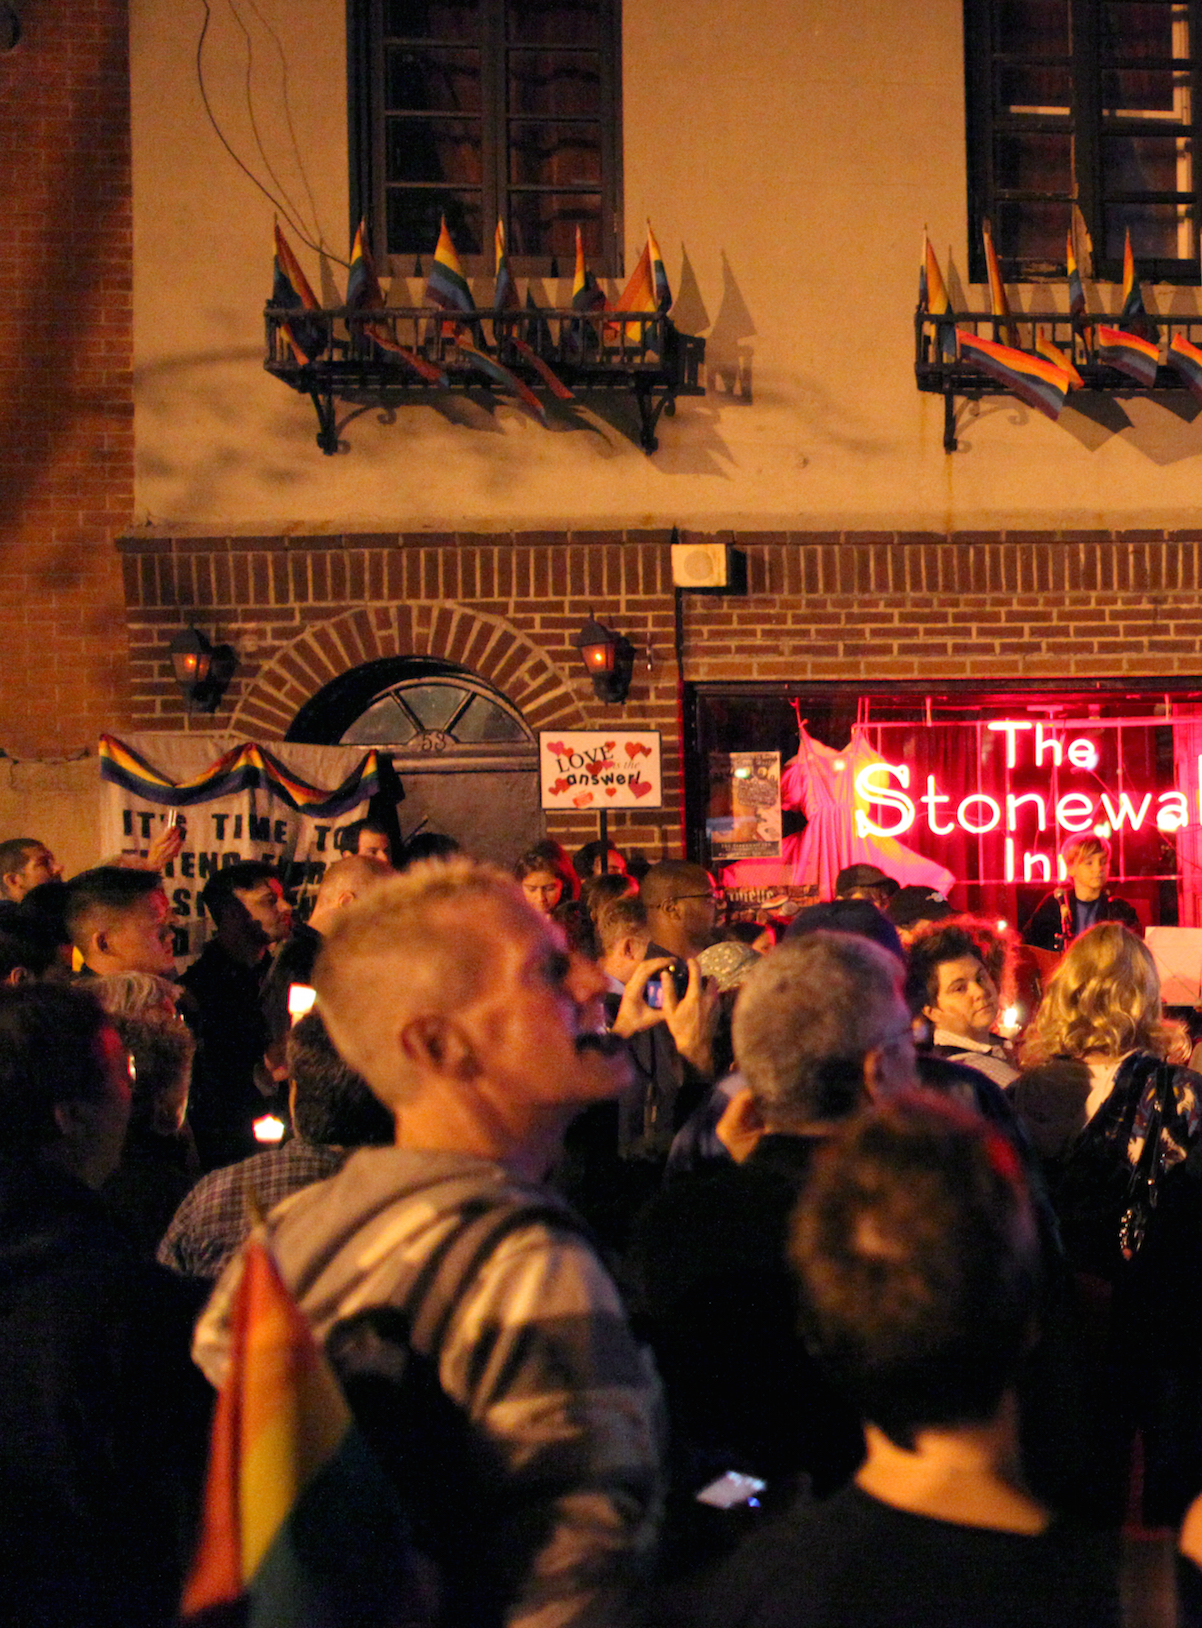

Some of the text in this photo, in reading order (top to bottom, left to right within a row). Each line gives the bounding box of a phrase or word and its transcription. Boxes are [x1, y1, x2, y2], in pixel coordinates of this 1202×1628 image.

[555, 744, 614, 773] LOVE
[988, 721, 1096, 769] The
[566, 770, 641, 786] answer!
[623, 760, 640, 770] the
[211, 814, 287, 843] TIME
